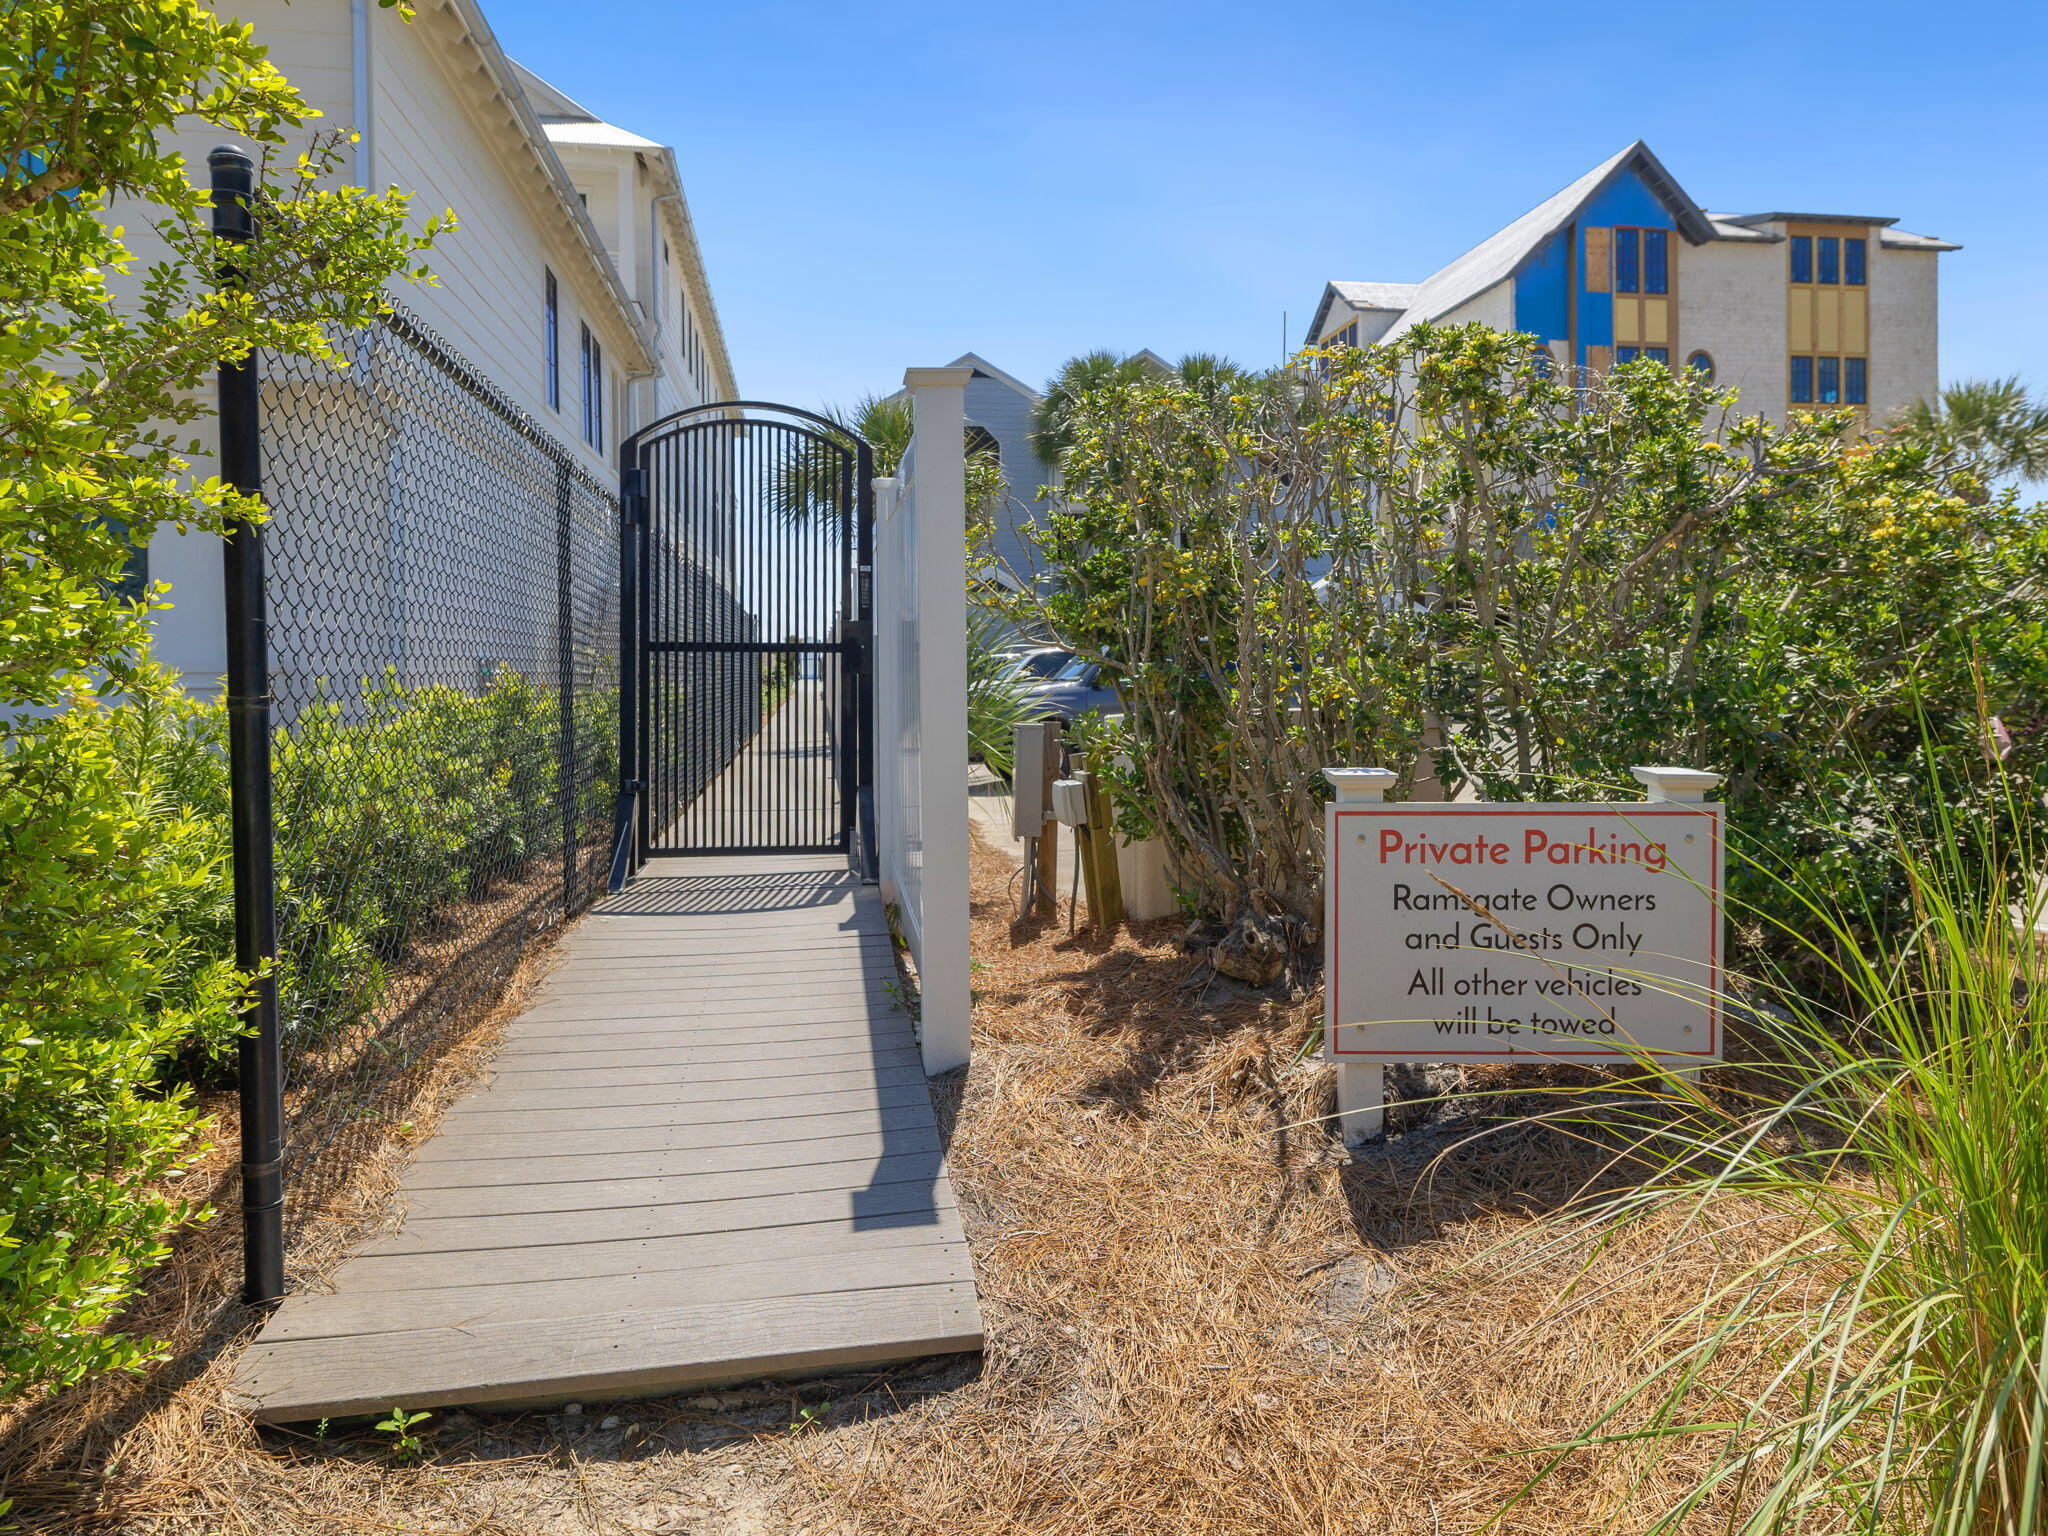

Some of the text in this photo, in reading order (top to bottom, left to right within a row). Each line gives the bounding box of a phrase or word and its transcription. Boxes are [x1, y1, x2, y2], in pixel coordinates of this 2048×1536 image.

[1380, 826, 1667, 874] Private Parking
[1547, 883, 1656, 911] Owners
[1405, 921, 1643, 957] and Guests Only
[1407, 966, 1642, 996] All other vehicles
[1433, 1006, 1616, 1035] will be towed
